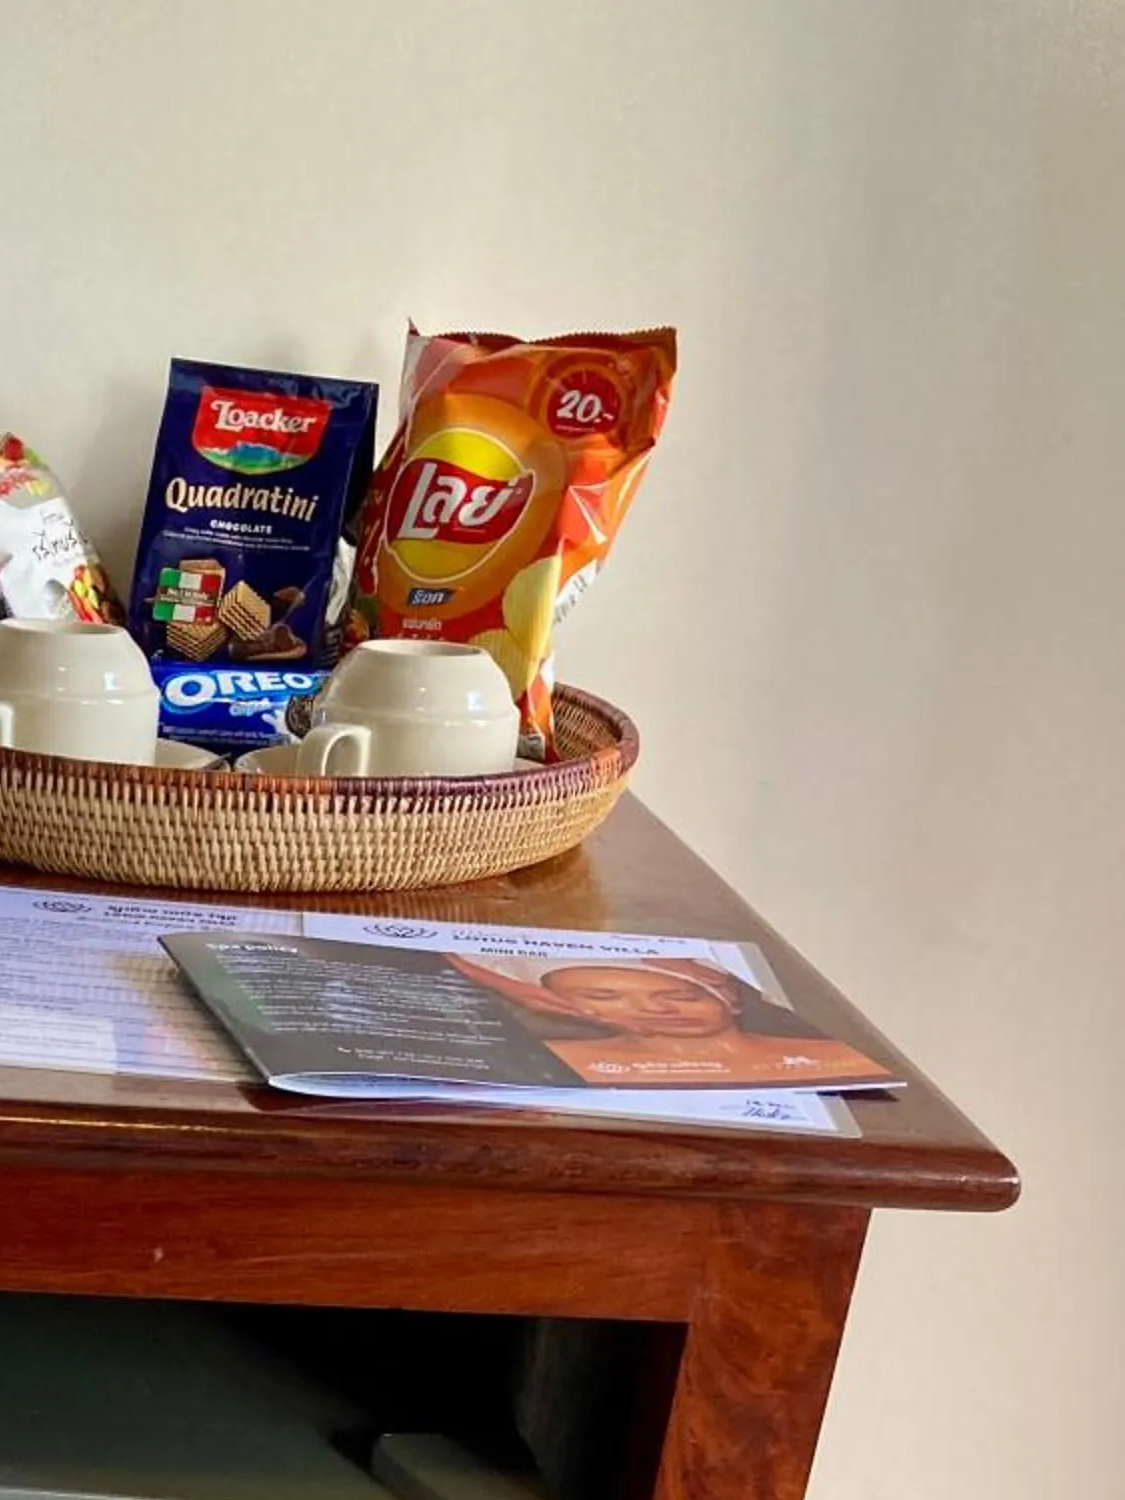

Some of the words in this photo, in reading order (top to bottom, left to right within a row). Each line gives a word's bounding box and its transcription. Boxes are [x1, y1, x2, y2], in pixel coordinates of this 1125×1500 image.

[210, 399, 316, 434] Loacker
[164, 476, 319, 522] Quadratini
[209, 519, 273, 535] CHOCOLATE
[165, 670, 313, 708] OREO
